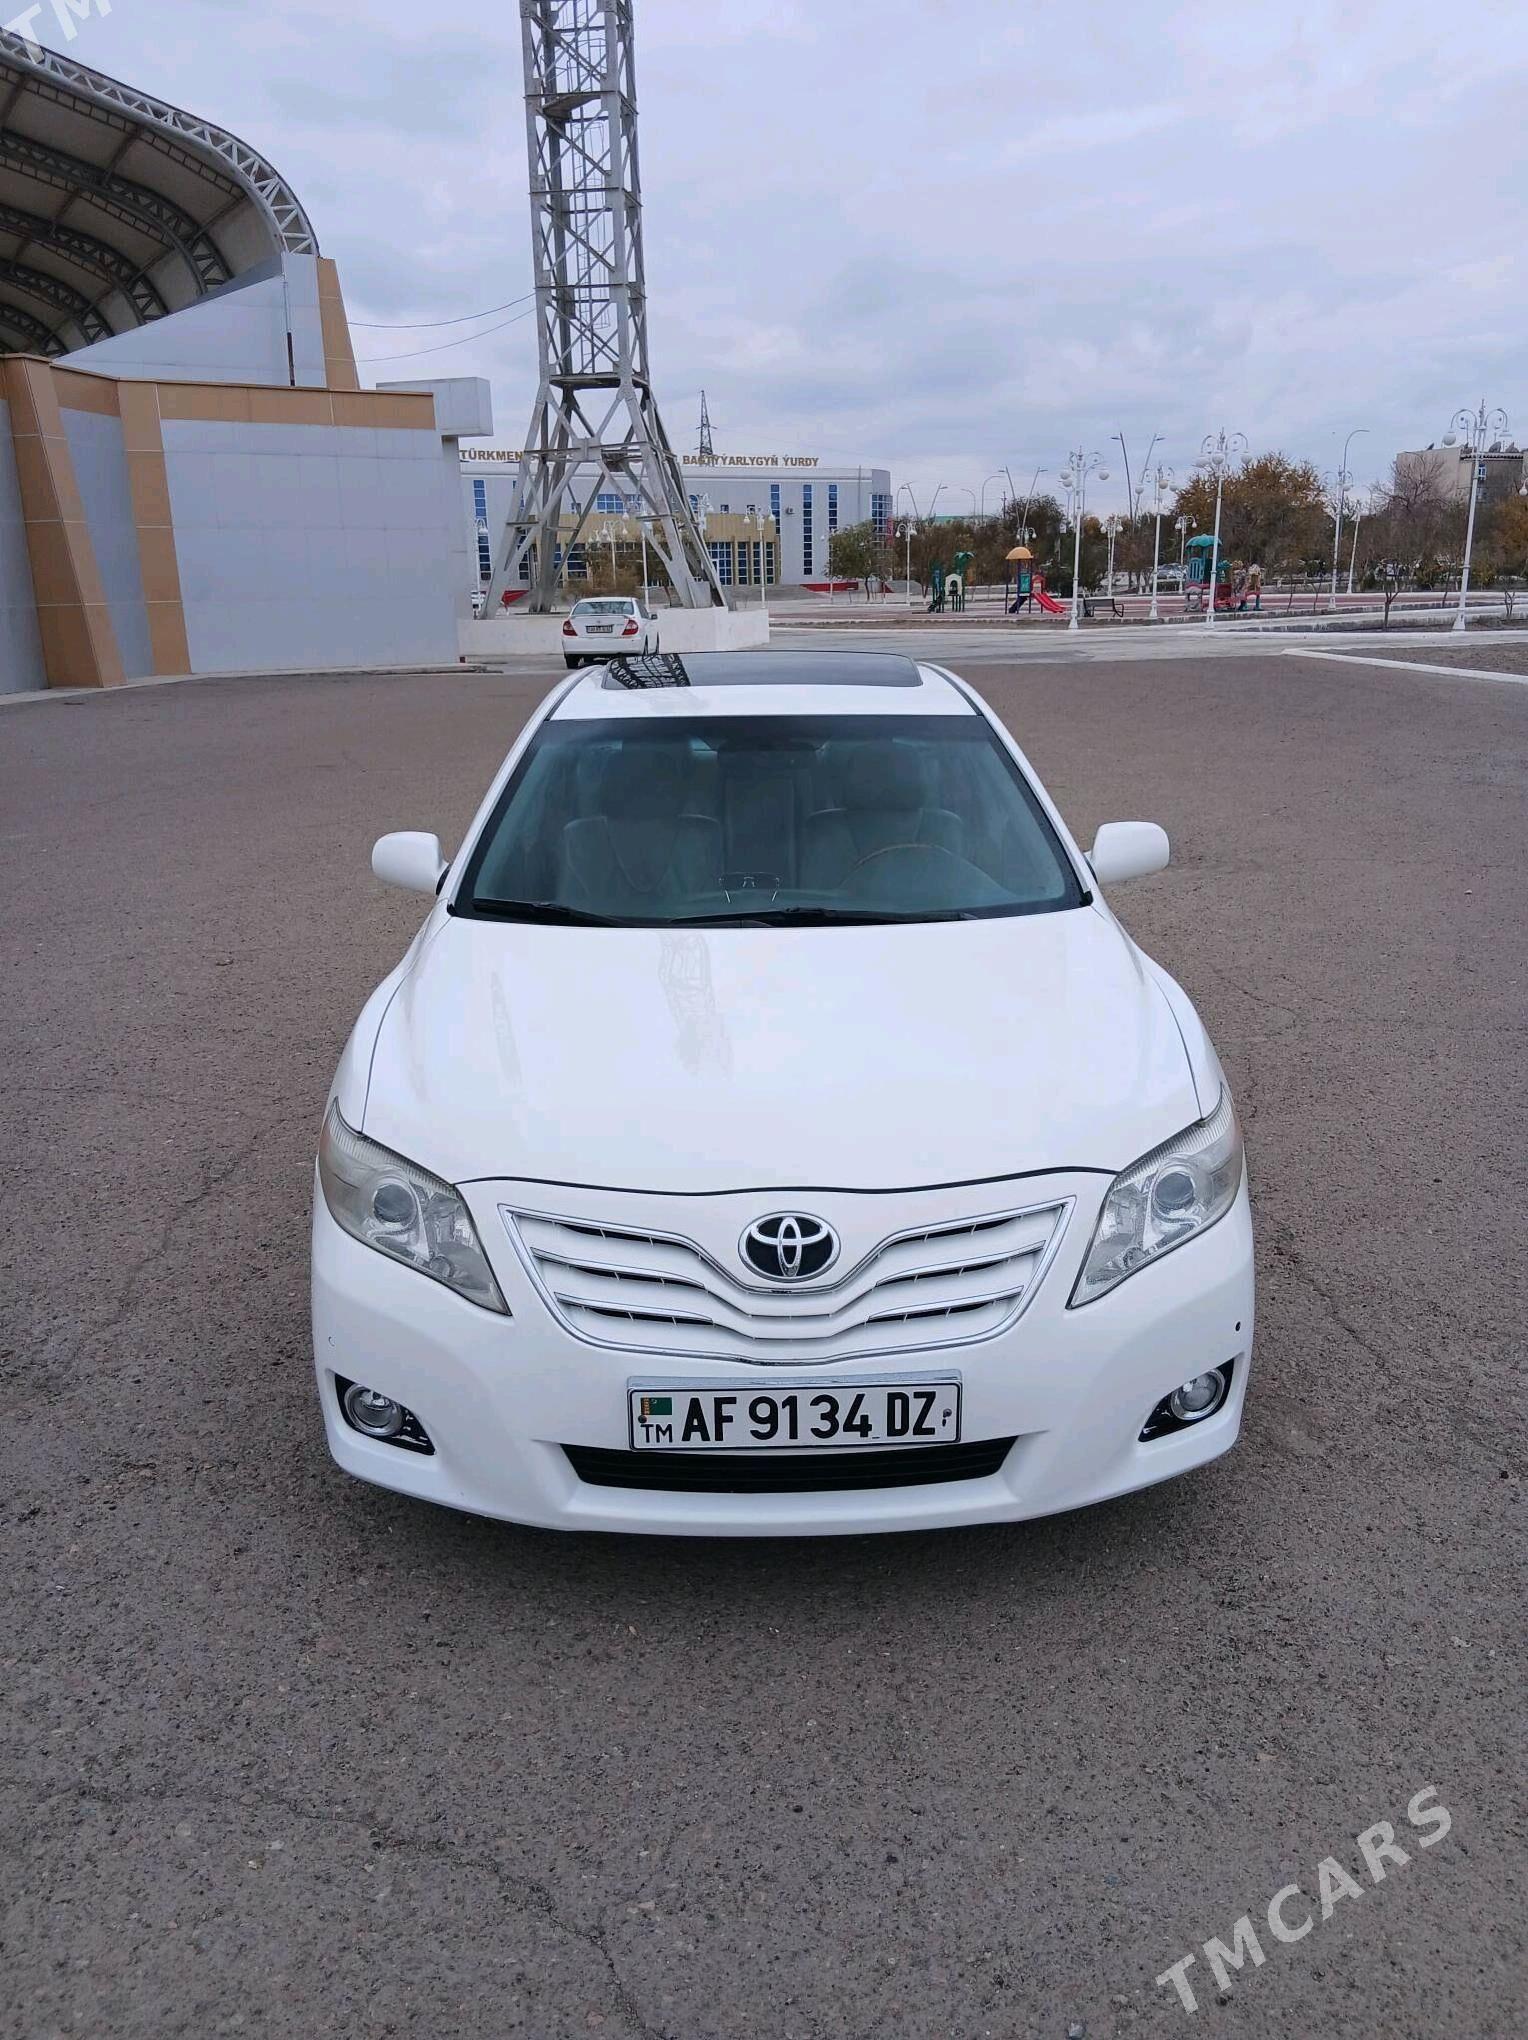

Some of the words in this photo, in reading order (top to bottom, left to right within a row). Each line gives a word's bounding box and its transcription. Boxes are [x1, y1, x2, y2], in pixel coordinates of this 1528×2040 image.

[640, 1423, 673, 1443] TM
[681, 1397, 737, 1442] AF
[886, 1391, 937, 1438] DZ
